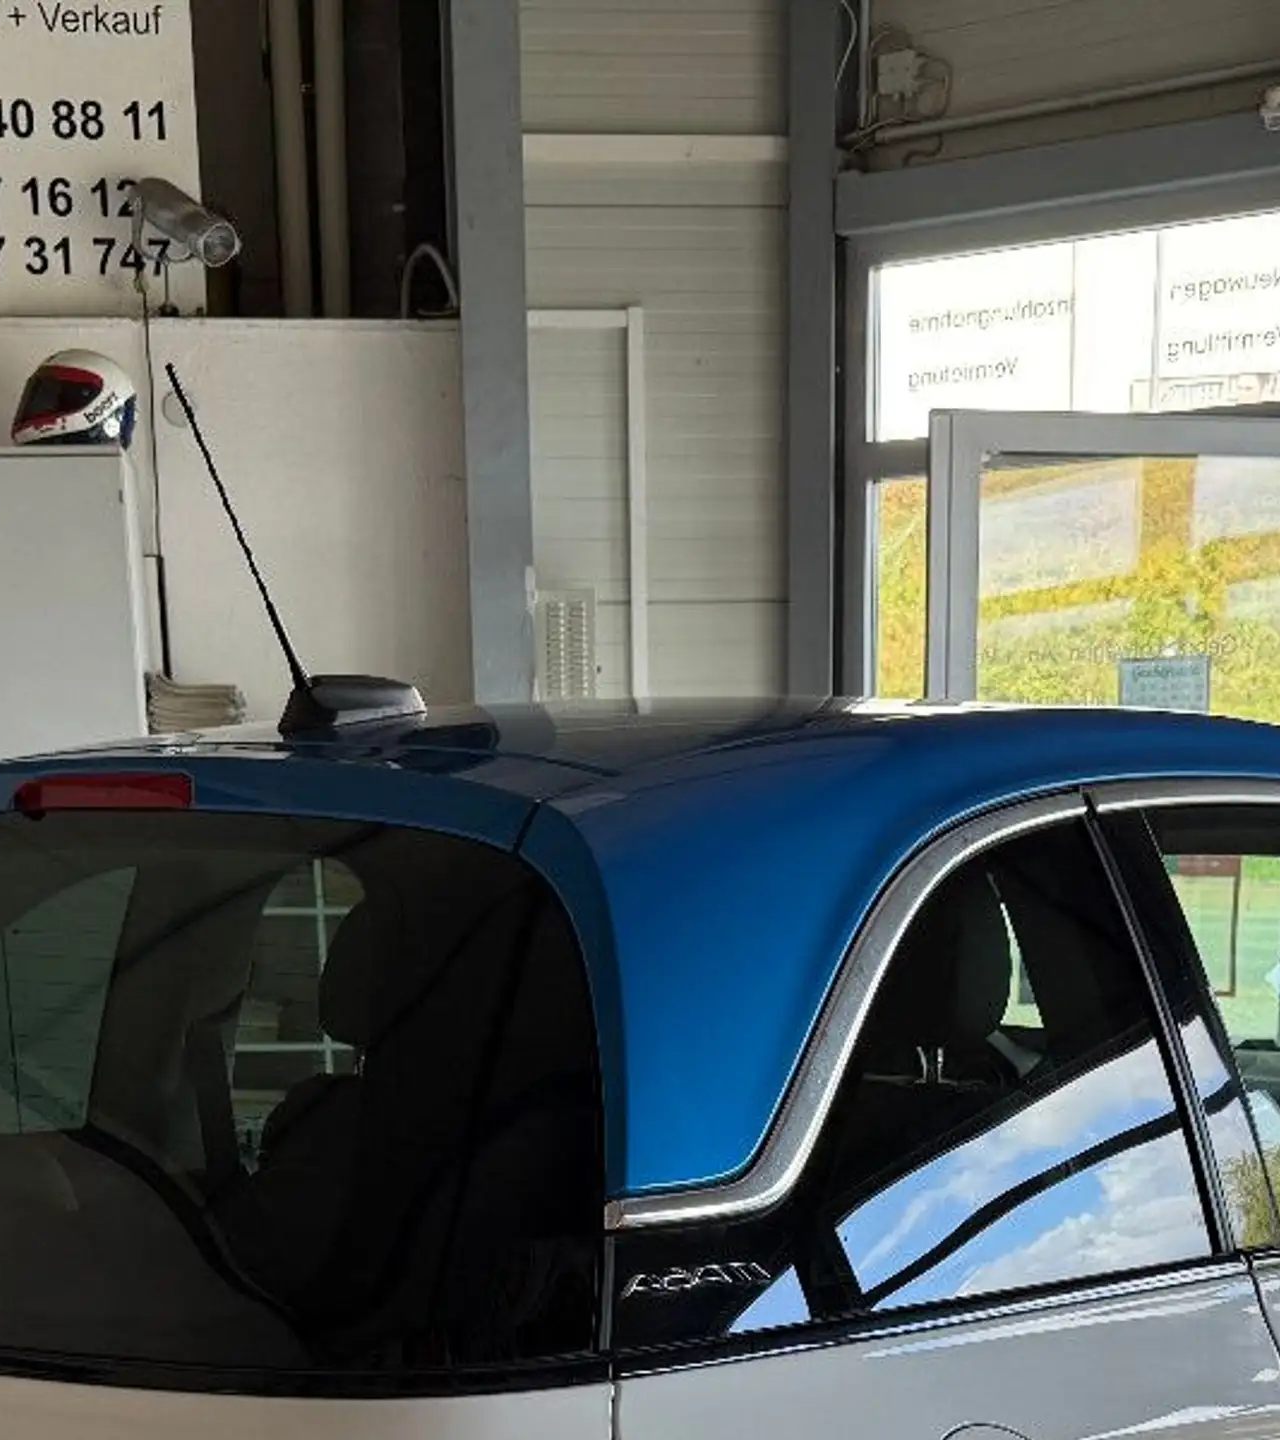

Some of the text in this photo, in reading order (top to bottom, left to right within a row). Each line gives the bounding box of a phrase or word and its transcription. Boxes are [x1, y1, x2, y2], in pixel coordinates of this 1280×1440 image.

[7, 7, 26, 26] +
[37, 2, 161, 35] Verkauf
[52, 100, 105, 139] 88
[123, 101, 166, 140] 11
[22, 177, 72, 217] 16
[24, 236, 71, 275] 31
[93, 237, 170, 276] 747
